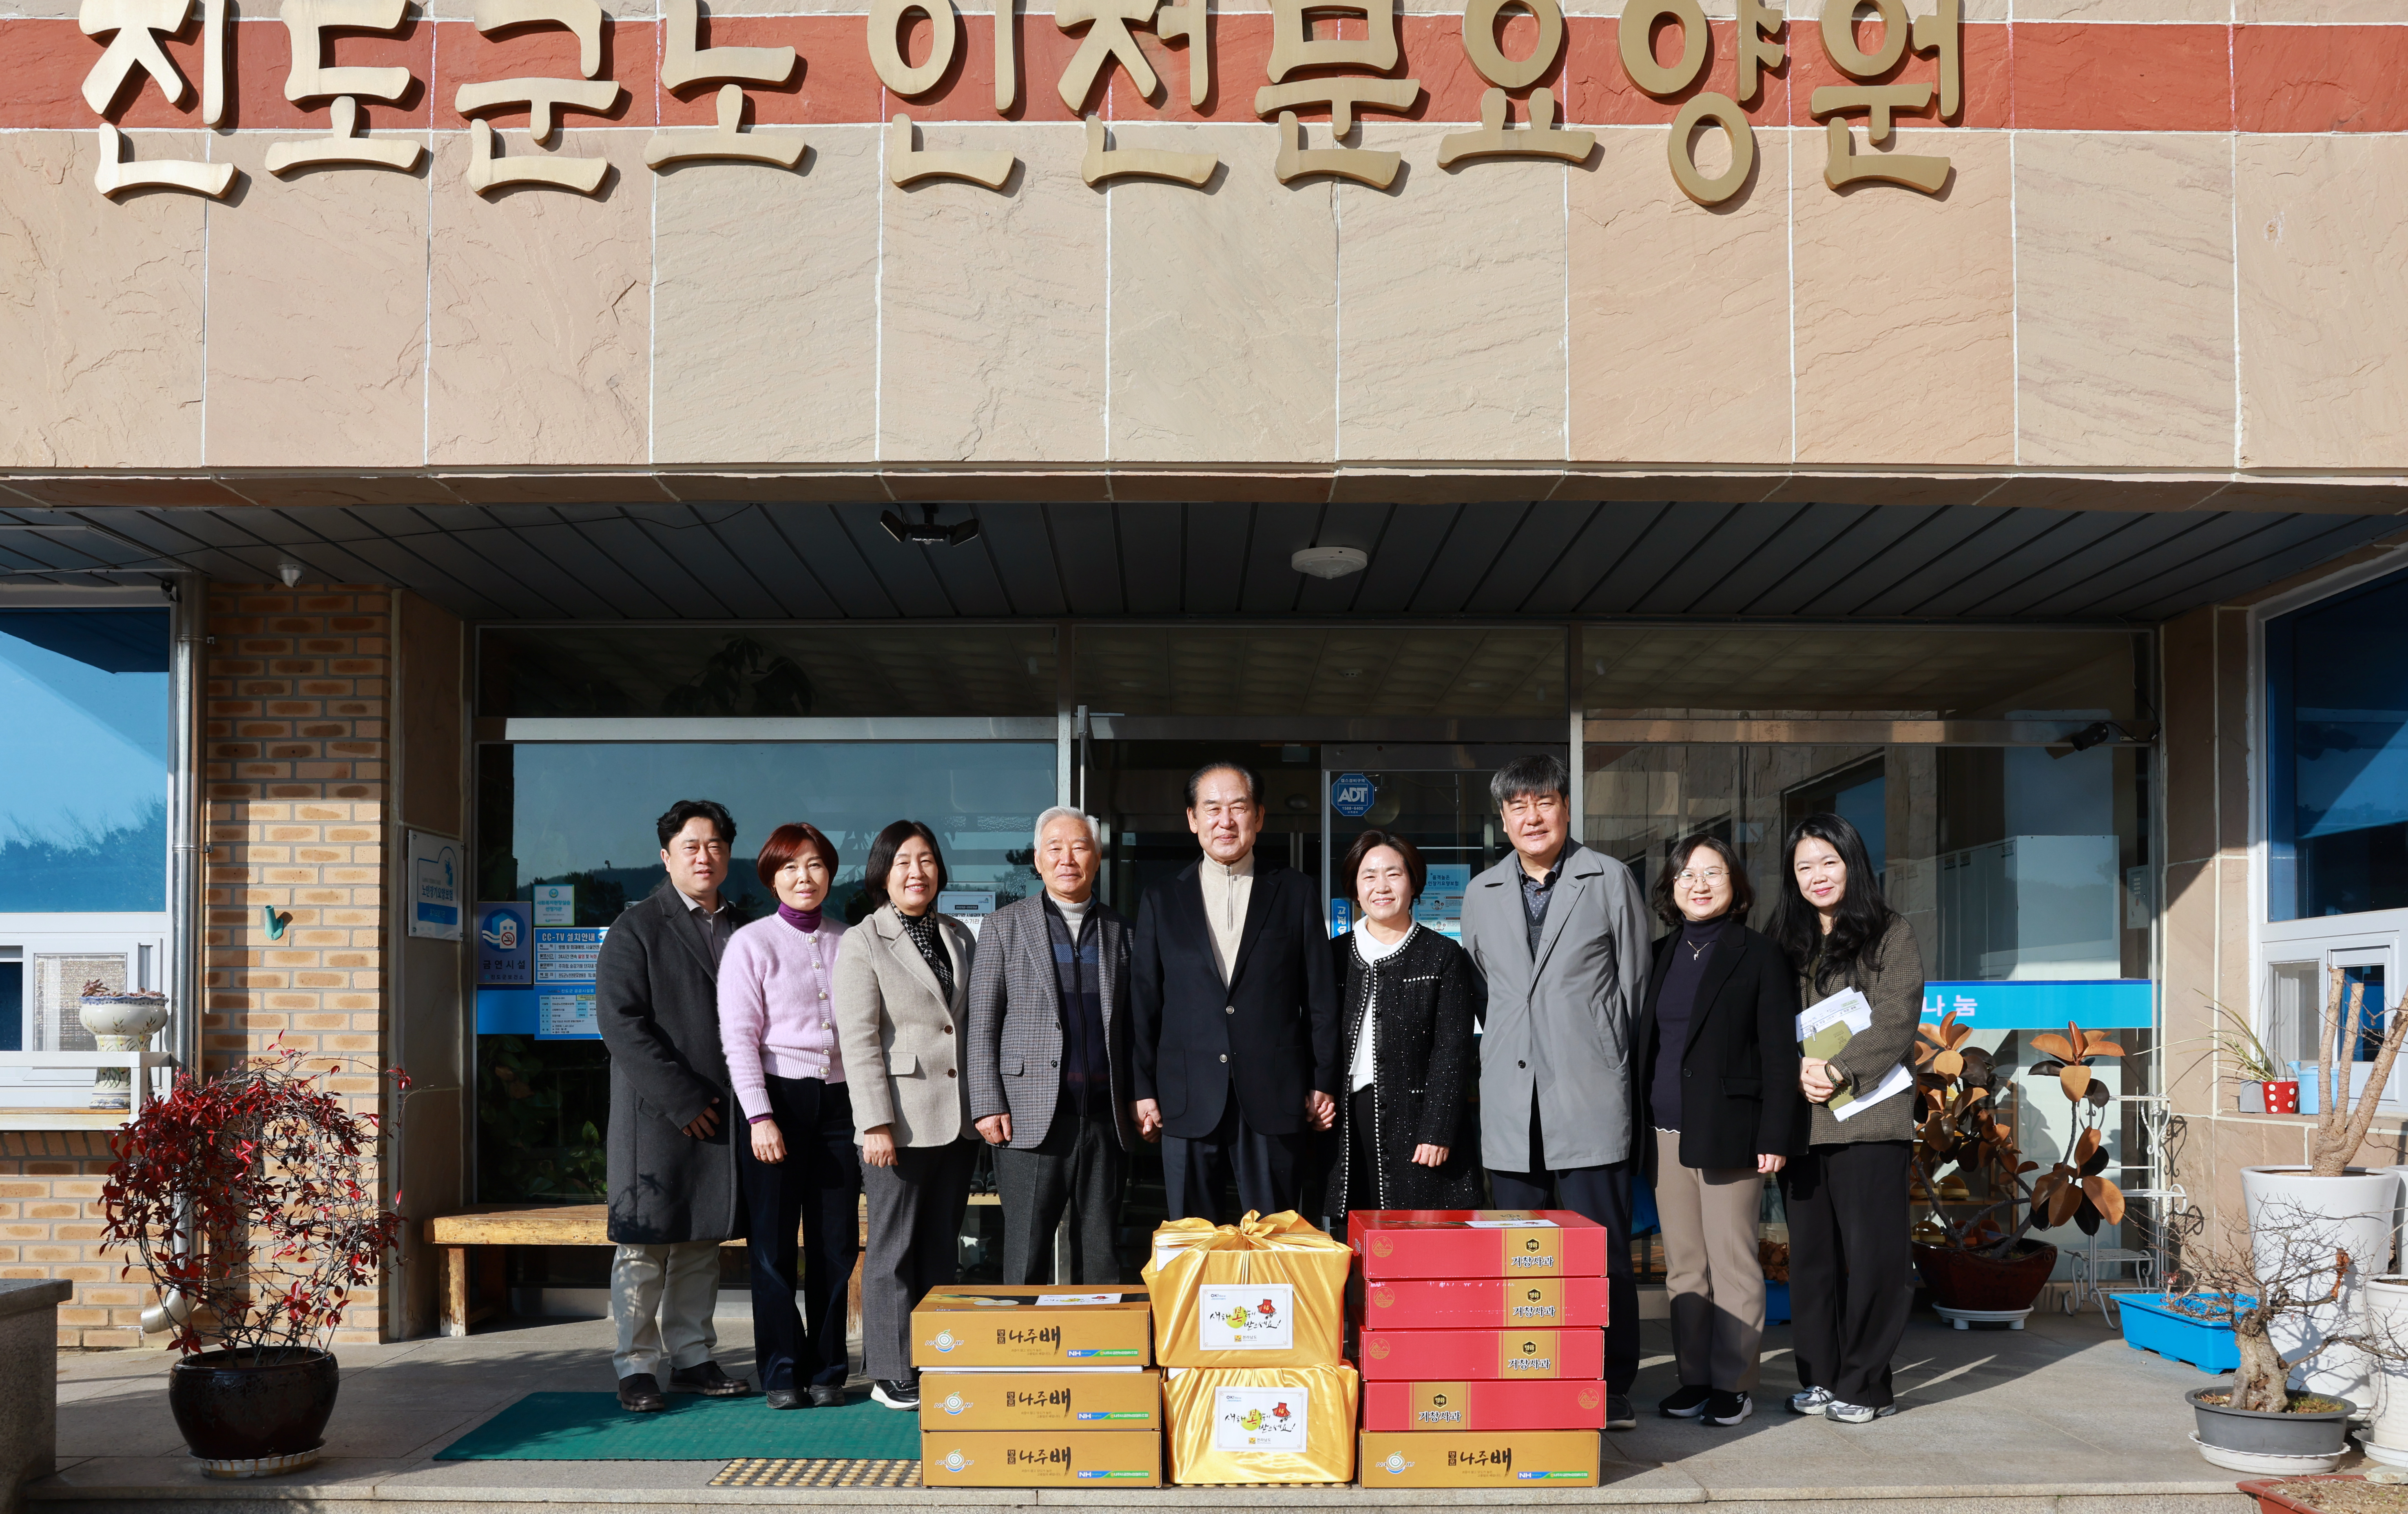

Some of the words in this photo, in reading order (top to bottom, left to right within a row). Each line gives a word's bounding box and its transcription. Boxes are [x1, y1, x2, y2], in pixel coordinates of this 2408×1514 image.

[1338, 787, 1368, 802] ADT
[422, 885, 453, 901] 노인장기요양보험
[542, 933, 564, 941] CC-TV
[567, 933, 595, 942] 설치안내
[483, 960, 525, 969] 금연시설
[1922, 995, 1978, 1017] 나눔
[1511, 1256, 1554, 1268] 거창사과
[1232, 1306, 1243, 1325] 복
[1513, 1306, 1556, 1317] 거창사과
[997, 1329, 1006, 1344] 명품
[1009, 1326, 1061, 1357] 나주배
[1508, 1358, 1551, 1370] 거창사과
[1007, 1392, 1016, 1407] 명품
[1019, 1388, 1071, 1419] 나주배
[1247, 1408, 1258, 1427] 복
[1419, 1411, 1462, 1423] 거창사과
[1007, 1450, 1016, 1465] 명품
[1020, 1446, 1071, 1477] 나주배
[1448, 1451, 1457, 1466] 명품
[1460, 1448, 1512, 1479] 나주배
